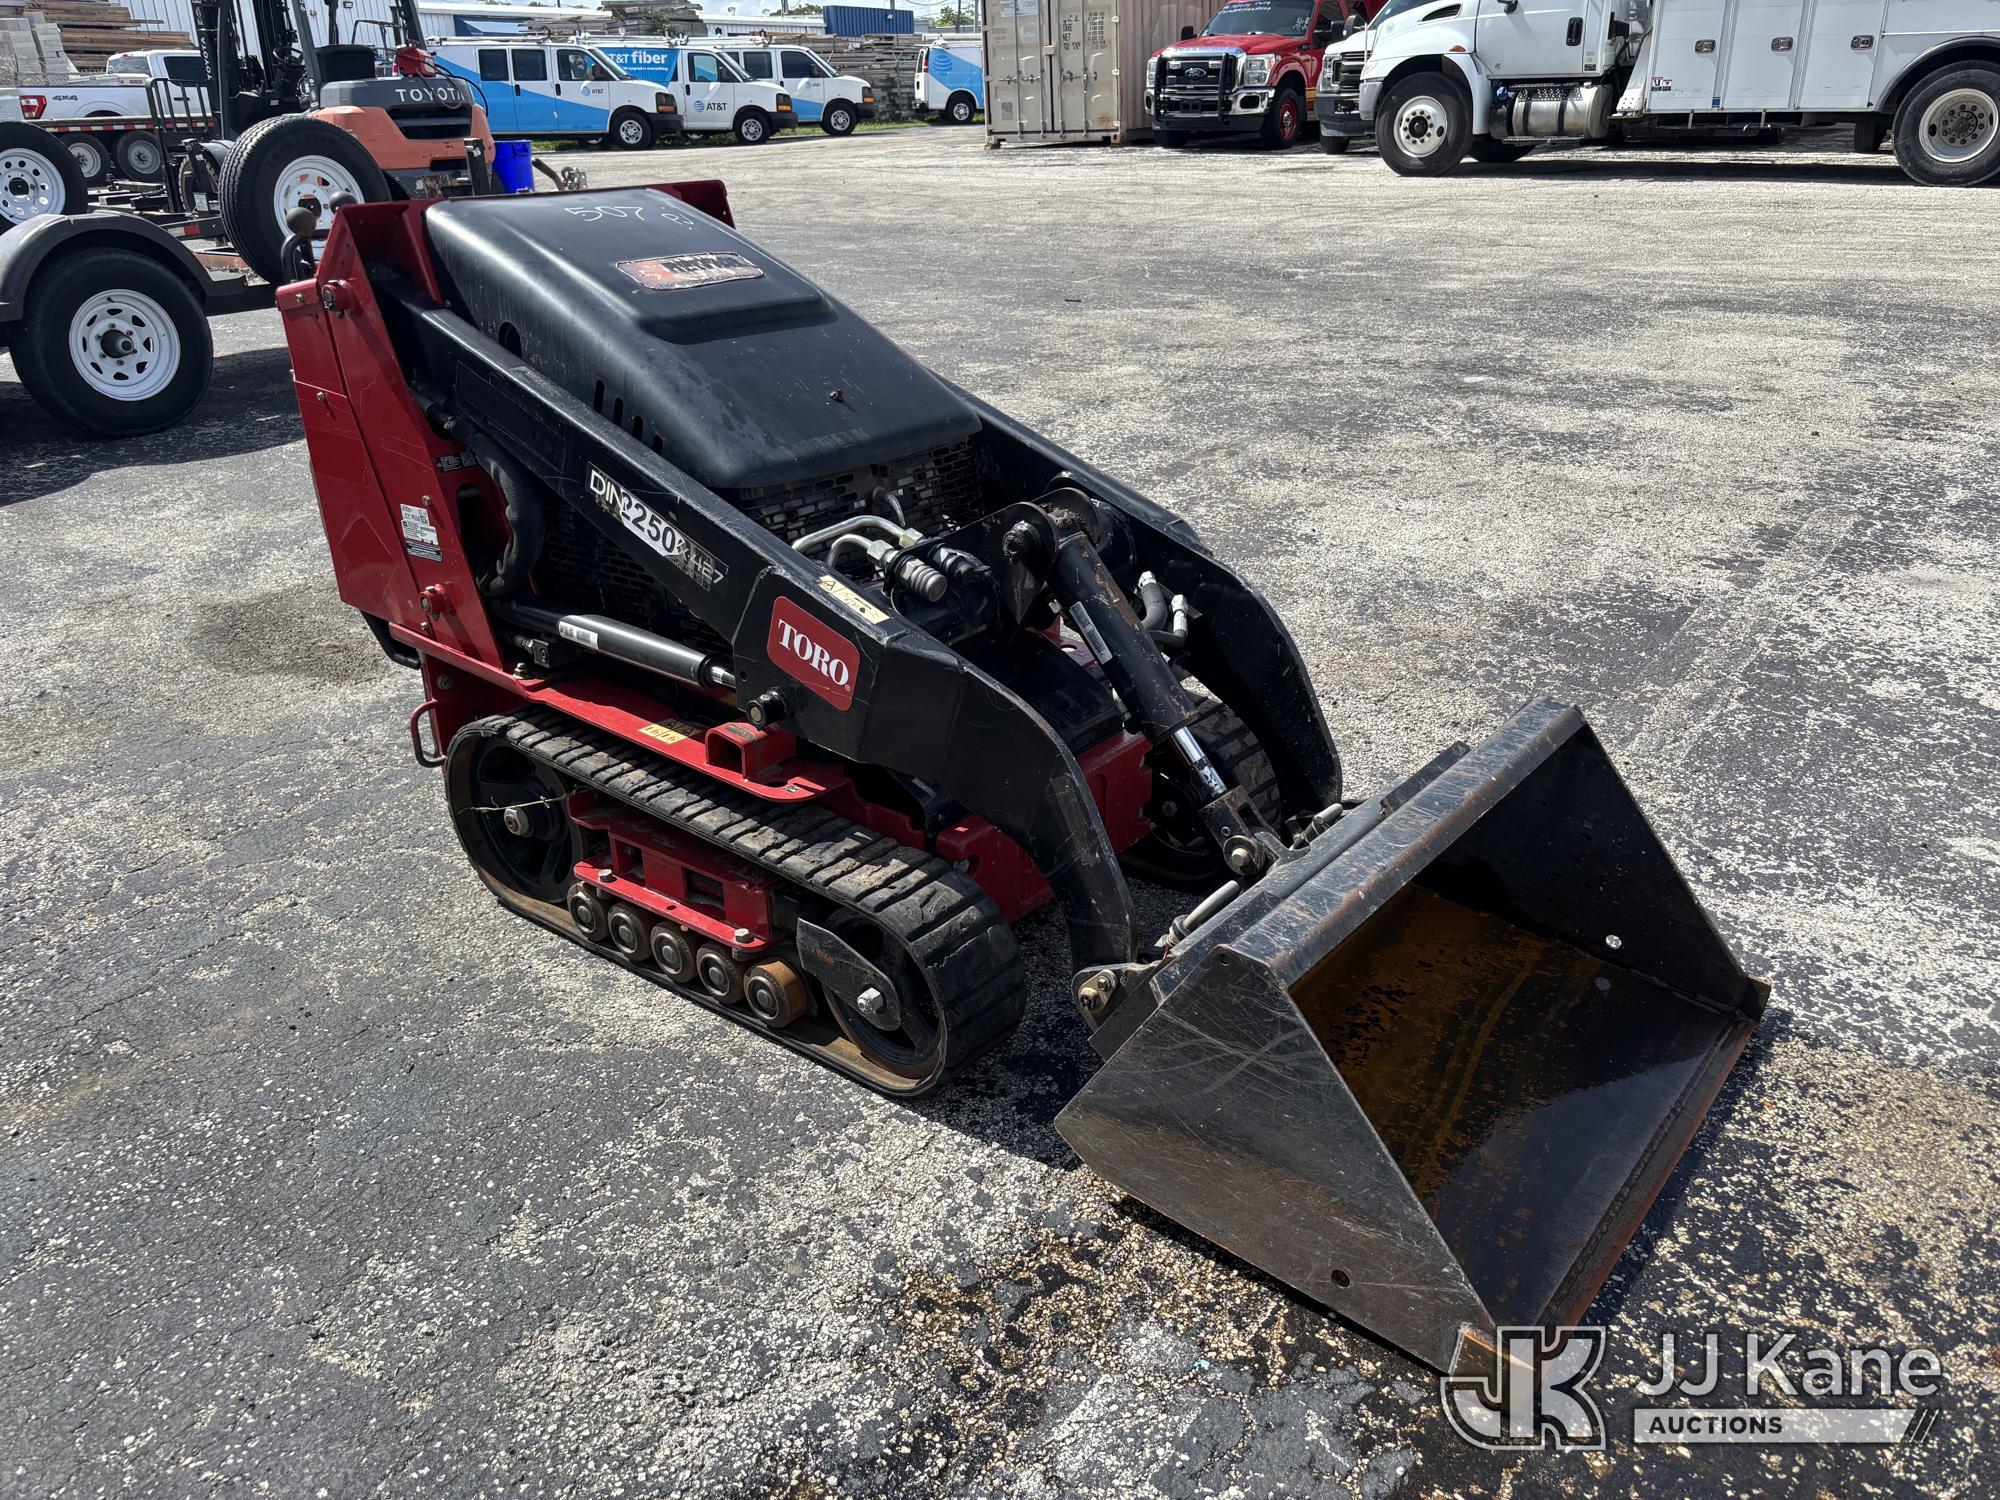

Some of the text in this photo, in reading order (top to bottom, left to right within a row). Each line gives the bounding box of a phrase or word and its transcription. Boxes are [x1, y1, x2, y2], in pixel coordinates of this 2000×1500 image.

[200, 36, 213, 80] TOYOTA
[608, 51, 668, 64] T&T fiber
[395, 86, 465, 102] TOYOTA
[706, 102, 728, 111] AT&T
[564, 205, 646, 222] 507
[777, 618, 850, 687] TORO
